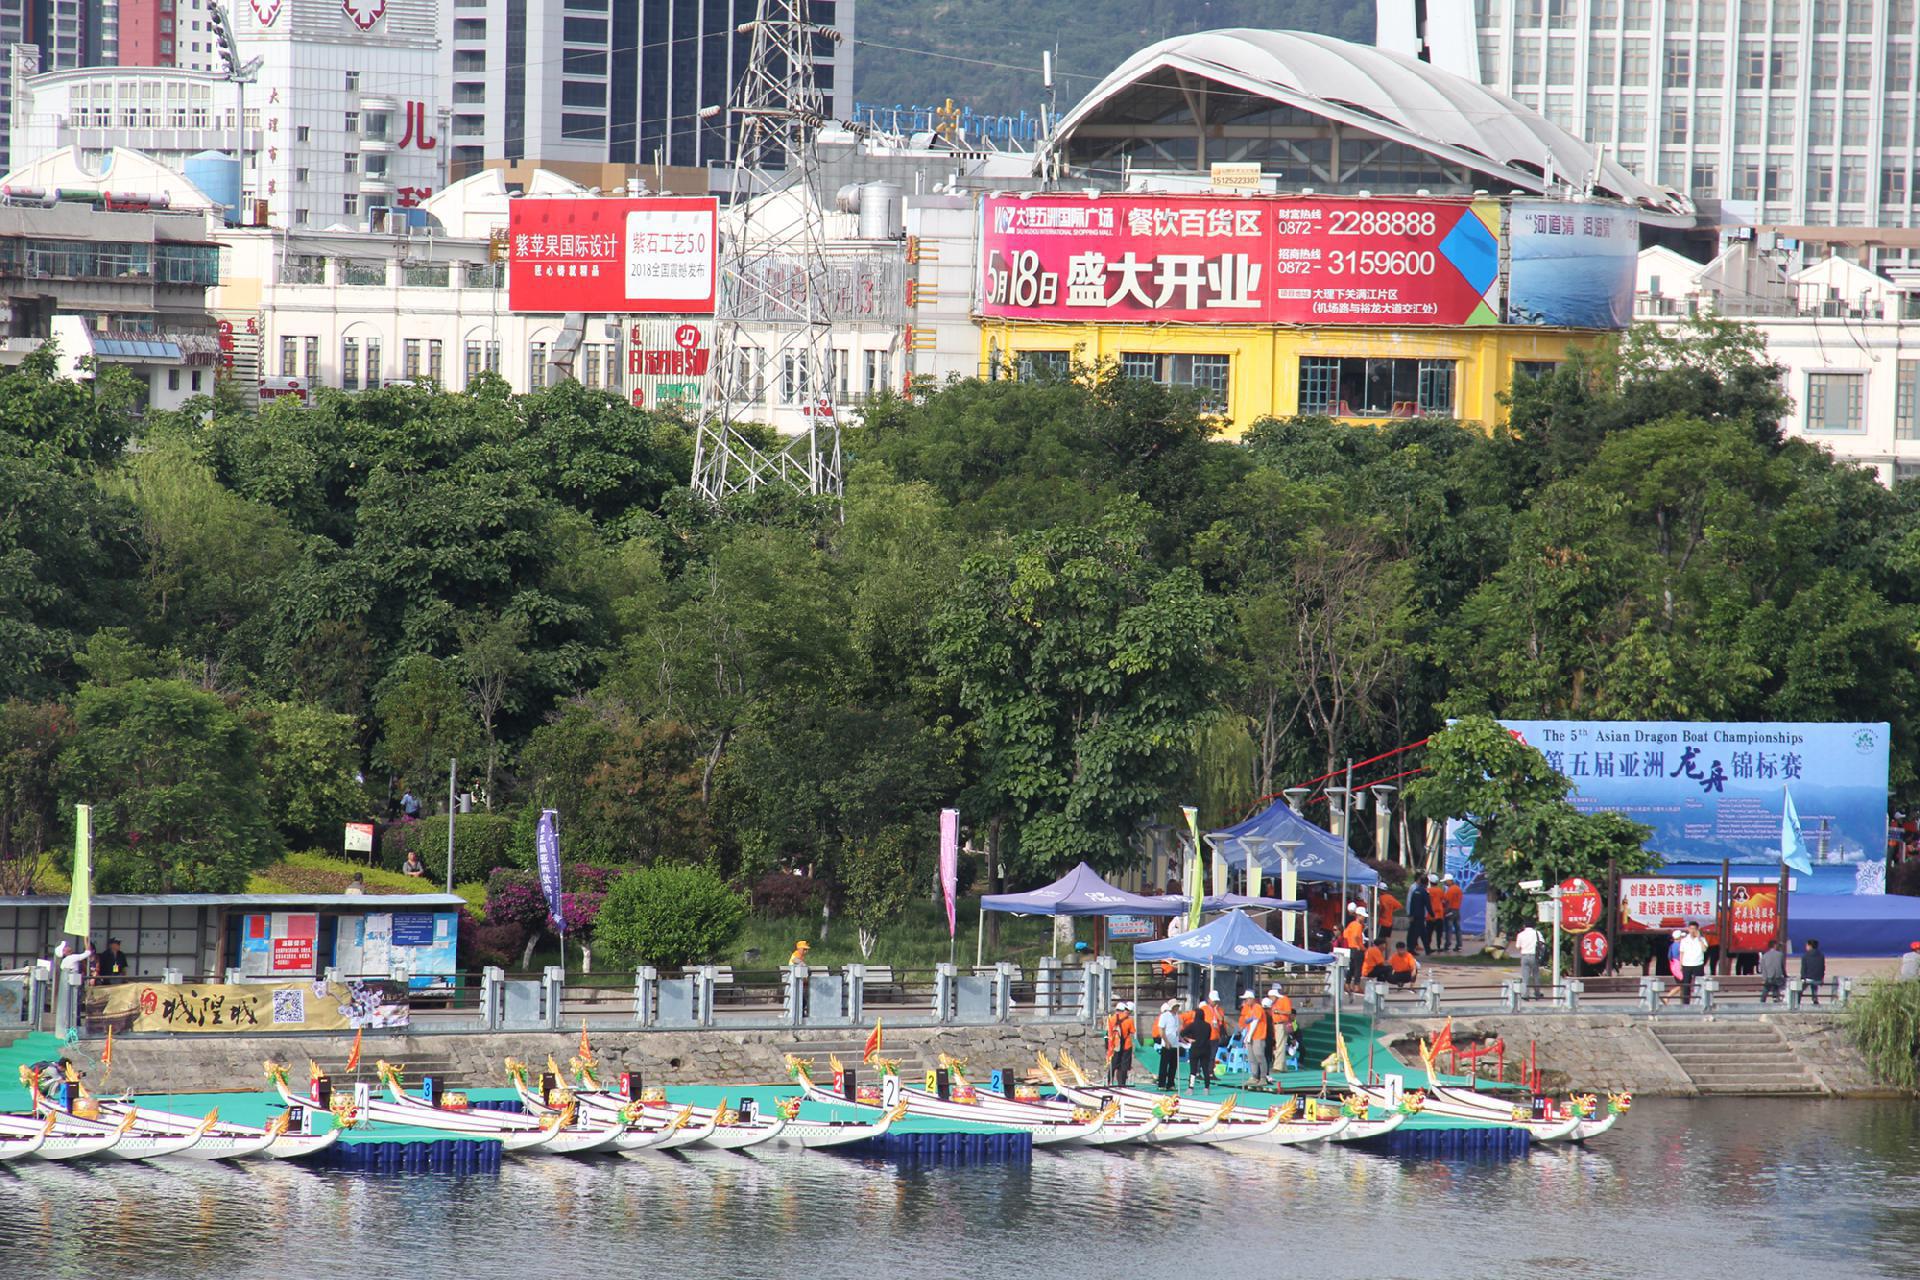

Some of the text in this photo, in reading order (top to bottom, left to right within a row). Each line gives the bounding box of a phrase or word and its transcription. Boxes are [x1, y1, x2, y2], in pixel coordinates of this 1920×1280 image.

[1128, 207, 1262, 237] 餐饮百货区
[1327, 211, 1436, 236] 2288888
[515, 233, 618, 258] 紫苹果国际设计
[632, 232, 706, 255] 紫石工艺5.0
[1327, 251, 1436, 276] 3159600
[1065, 251, 1262, 310] 盛大开业
[1543, 729, 1565, 742] The
[1595, 730, 1630, 742] Asian
[1635, 730, 1677, 744] Dragon
[1682, 730, 1708, 742] Boat
[1713, 730, 1803, 745] Championships
[1630, 883, 1703, 897] 创建全国文明城市
[1638, 901, 1711, 915] 建设美丽幸福大理
[424, 1082, 430, 1097] 3
[622, 1078, 627, 1092] 3
[835, 1075, 841, 1091] 2
[928, 1075, 934, 1089] 2
[993, 1075, 999, 1089] 2
[886, 1080, 895, 1107] 2
[1308, 1103, 1313, 1116] 4
[304, 1115, 309, 1127] 4
[582, 1110, 588, 1125] 3
